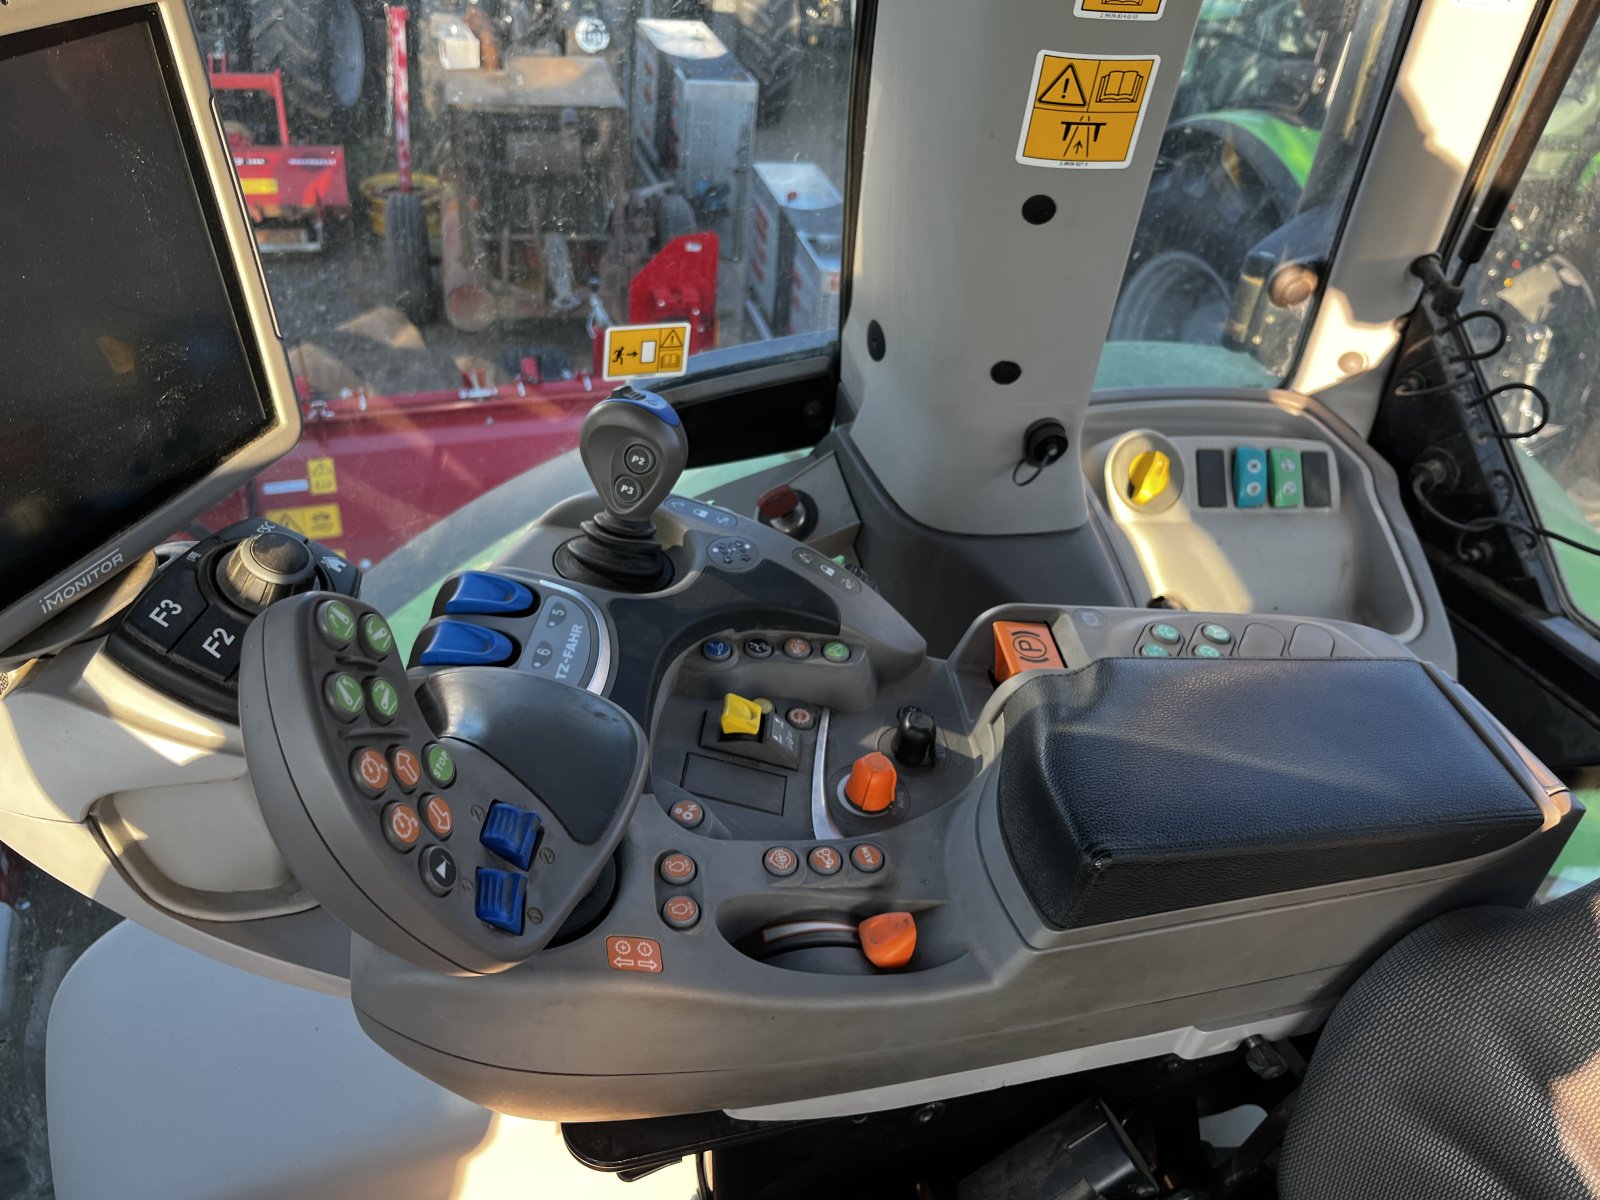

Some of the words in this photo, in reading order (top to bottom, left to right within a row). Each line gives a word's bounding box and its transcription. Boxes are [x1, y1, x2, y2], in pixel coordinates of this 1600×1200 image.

[631, 455, 646, 466] P2
[620, 484, 635, 495] P3
[38, 552, 124, 614] iMONITOR
[148, 599, 183, 629] F3
[551, 608, 565, 617] 5
[201, 628, 236, 660] F2
[536, 647, 551, 656] 6
[555, 623, 584, 680] TZ-FAHR
[432, 750, 448, 779] STOP
[860, 846, 874, 865] ASM
